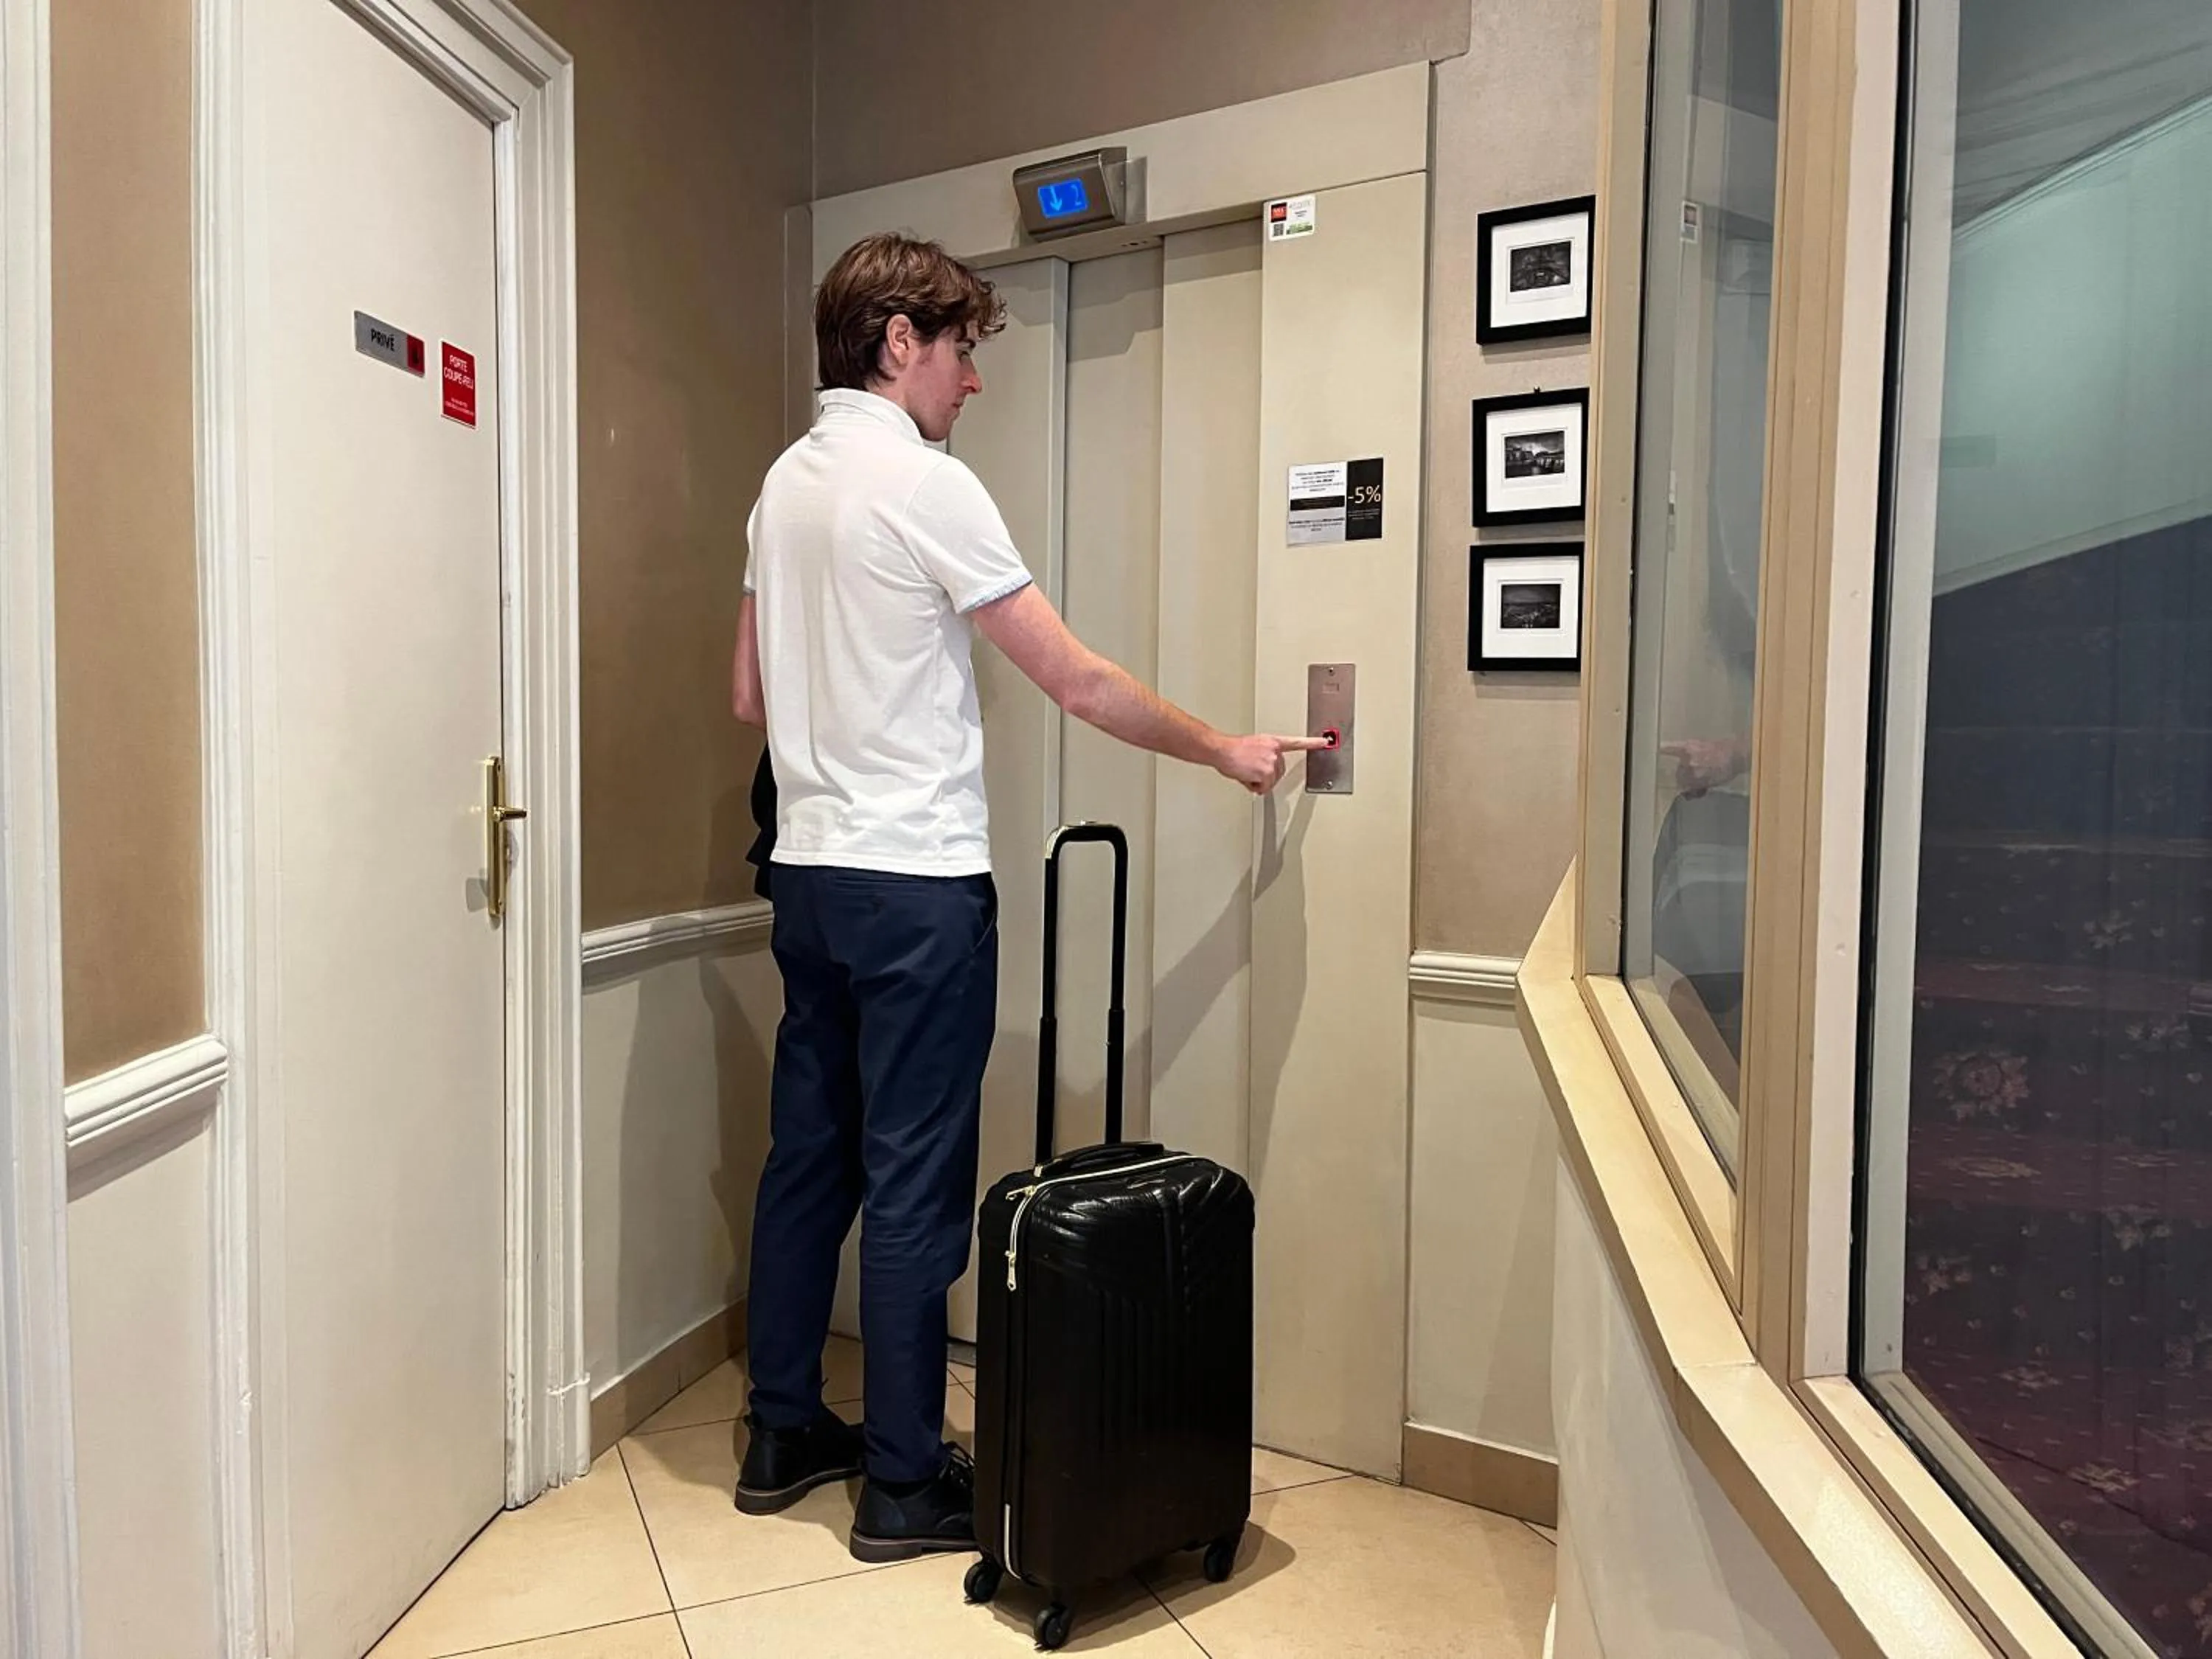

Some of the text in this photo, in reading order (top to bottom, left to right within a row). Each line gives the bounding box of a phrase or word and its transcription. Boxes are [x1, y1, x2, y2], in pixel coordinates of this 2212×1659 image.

[371, 328, 394, 351] PRIVÉ
[449, 355, 468, 372] PORTE
[1347, 484, 1381, 504] -5%
